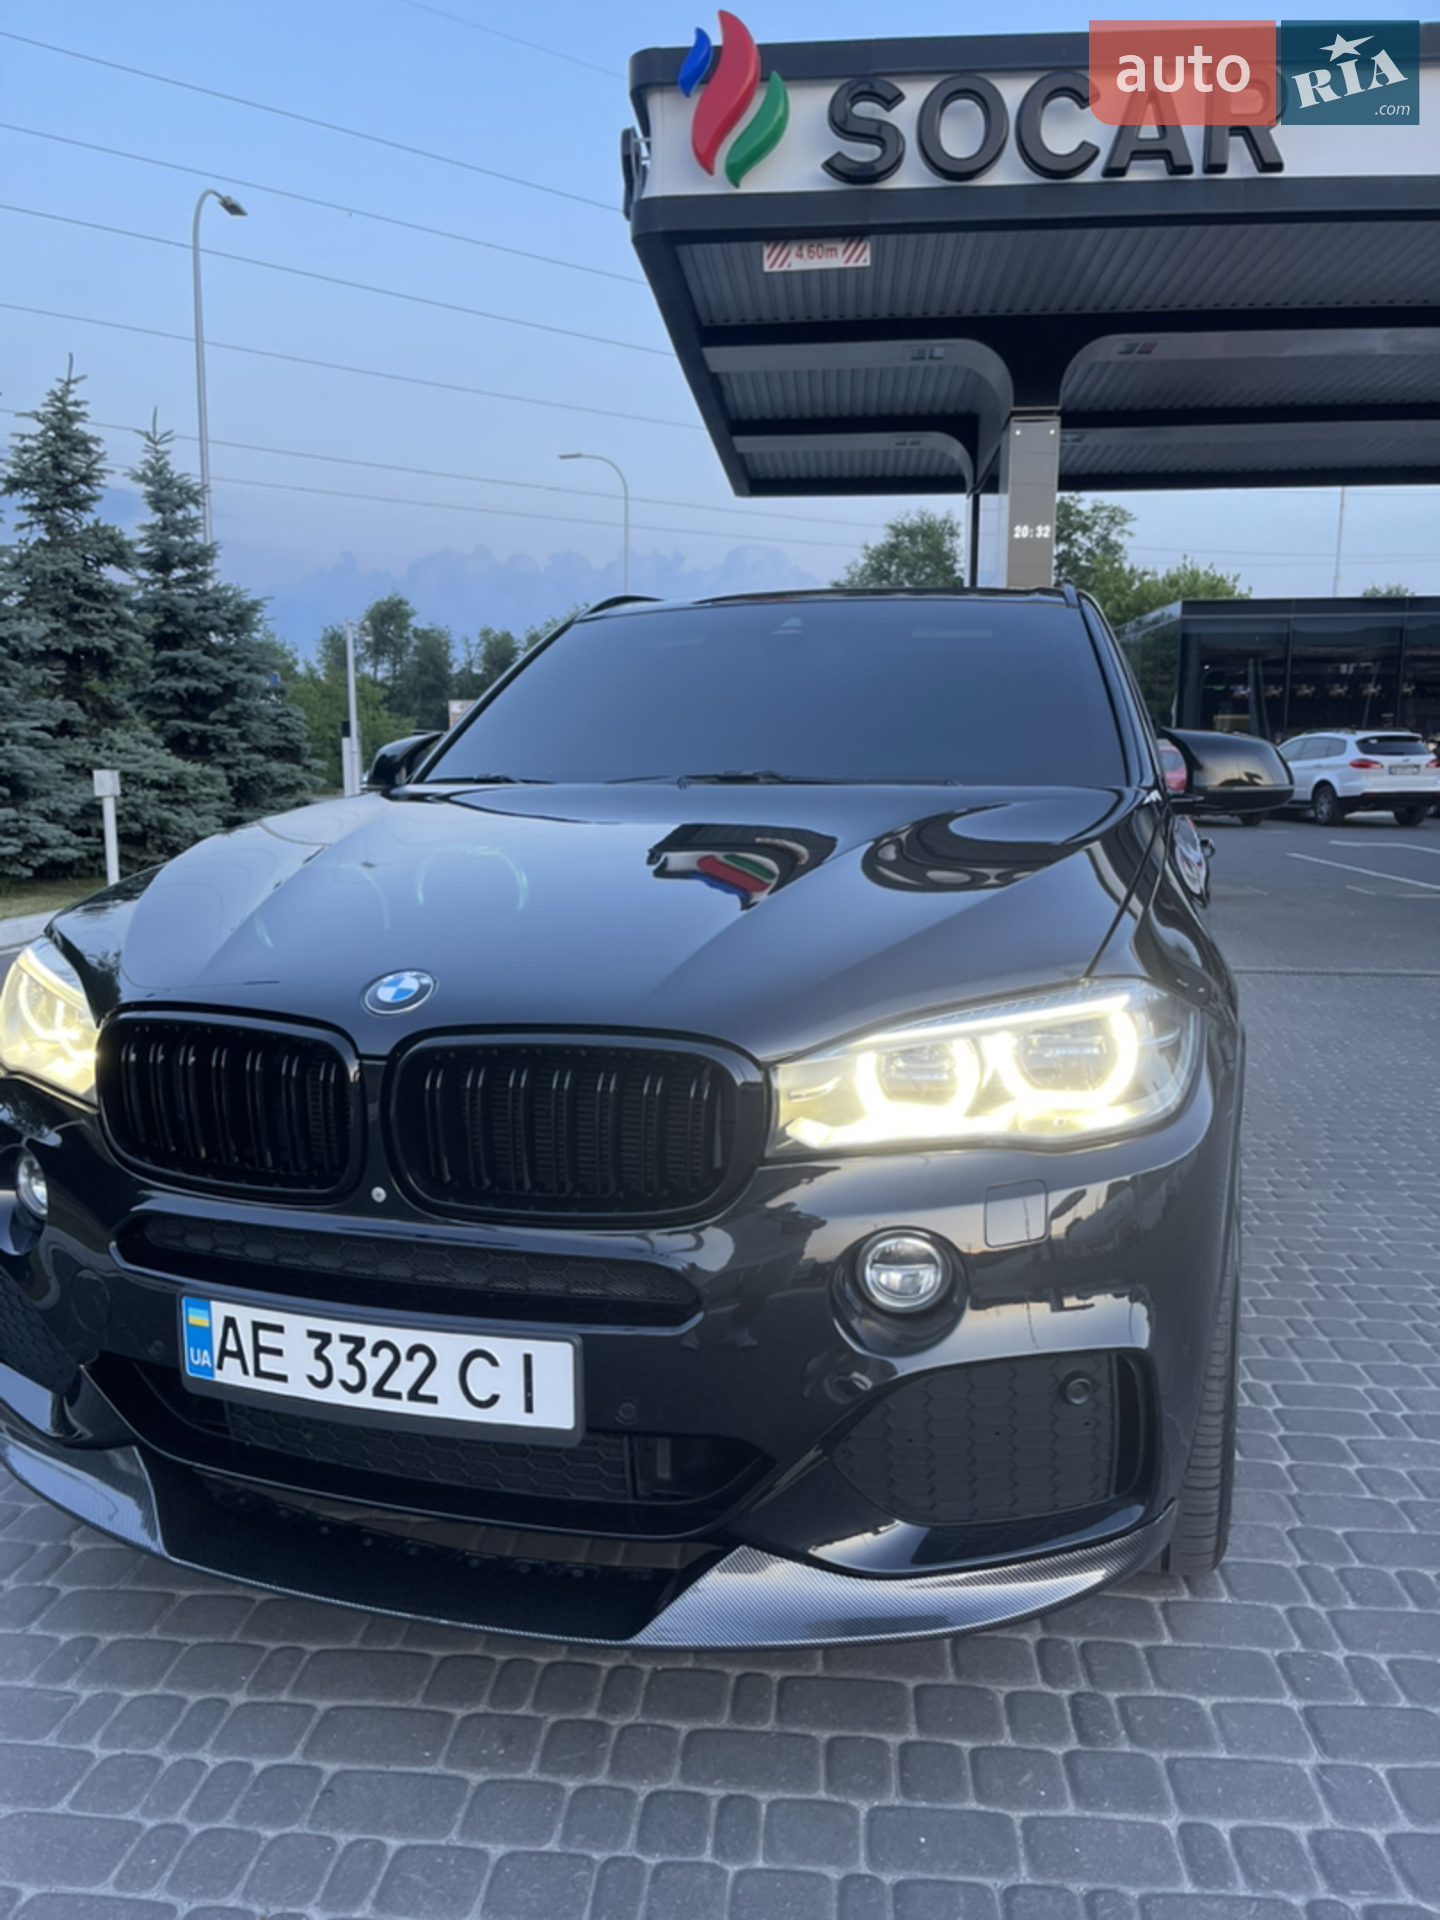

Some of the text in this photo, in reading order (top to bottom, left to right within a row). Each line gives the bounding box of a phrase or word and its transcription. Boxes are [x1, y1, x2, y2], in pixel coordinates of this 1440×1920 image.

[822, 70, 1287, 185] SOCAR
[190, 1347, 212, 1368] UA
[216, 1315, 288, 1383] AE
[306, 1330, 438, 1404] 3322
